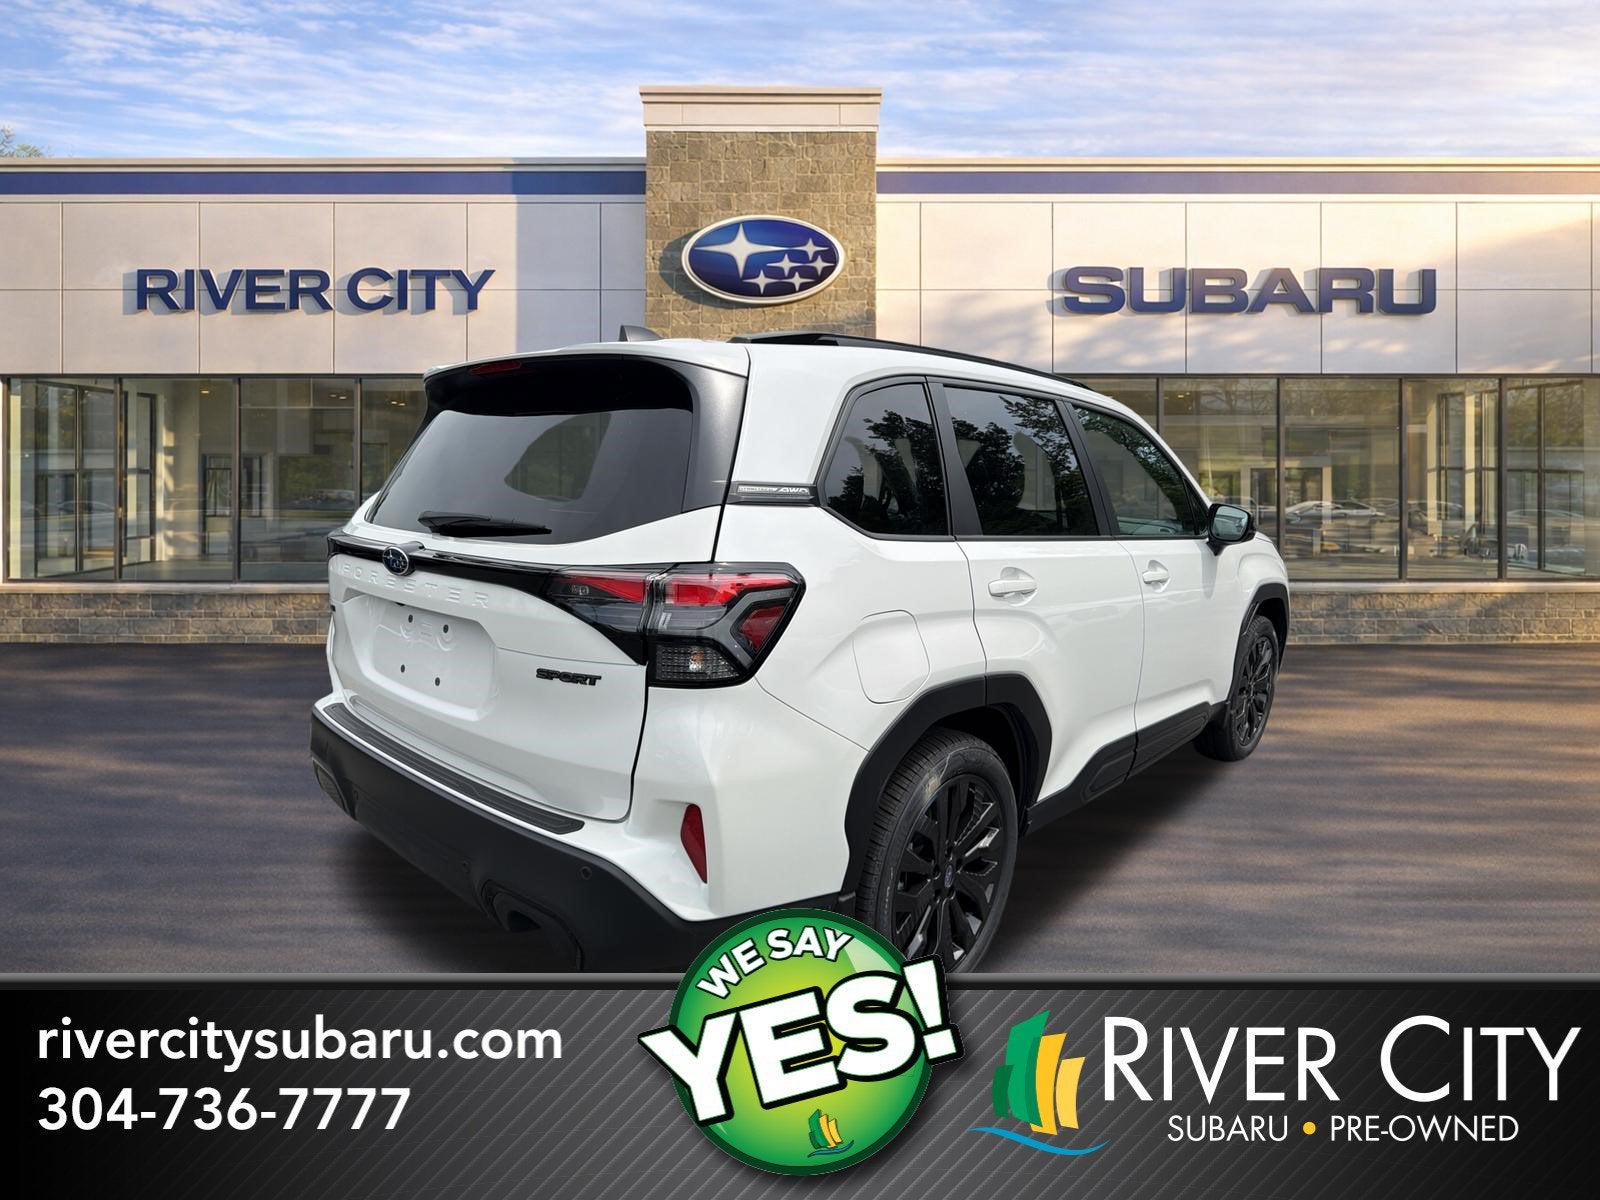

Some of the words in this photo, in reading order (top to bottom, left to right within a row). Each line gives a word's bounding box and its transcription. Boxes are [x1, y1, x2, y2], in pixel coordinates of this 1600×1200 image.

[136, 268, 334, 311] RIVER
[346, 266, 496, 311] CITY
[1063, 266, 1437, 315] SUBARU
[343, 563, 489, 609] FORESTER
[535, 667, 602, 686] SPORT
